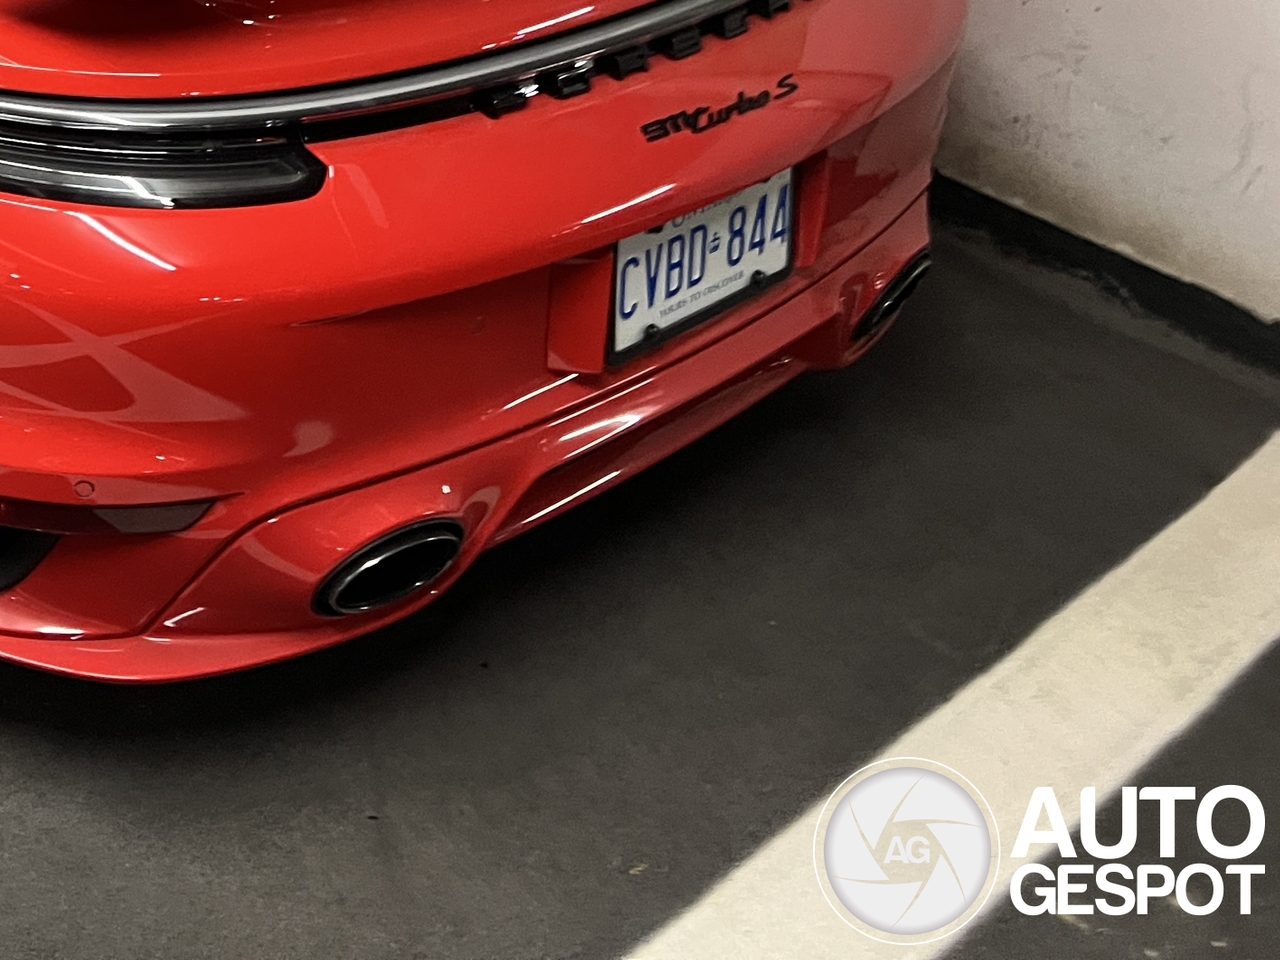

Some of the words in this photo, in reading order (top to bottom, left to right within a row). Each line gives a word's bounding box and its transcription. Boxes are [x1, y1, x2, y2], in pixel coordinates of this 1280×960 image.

[773, 73, 799, 100] S
[620, 224, 707, 320] CVBD
[727, 184, 790, 267] 844
